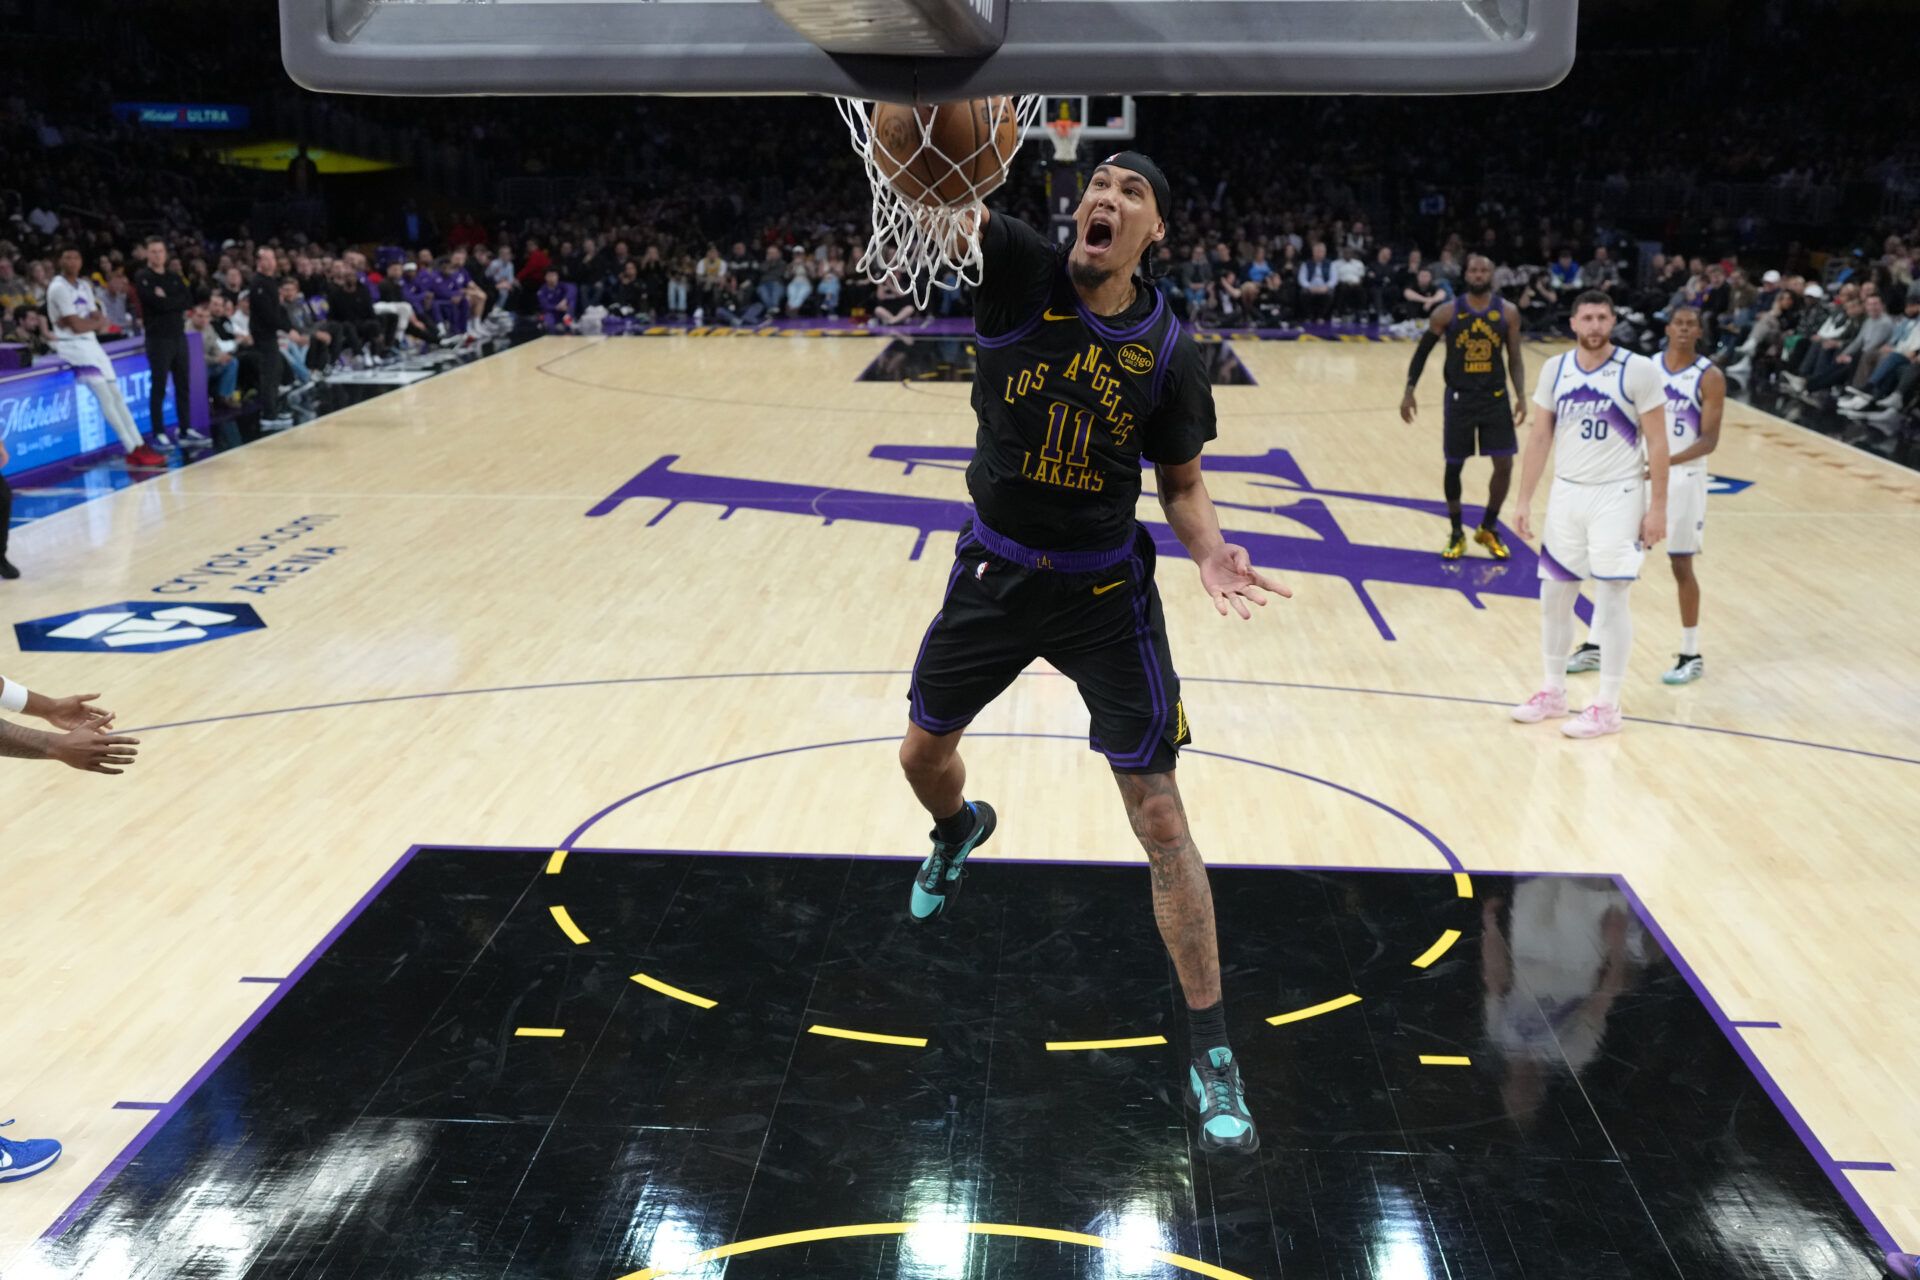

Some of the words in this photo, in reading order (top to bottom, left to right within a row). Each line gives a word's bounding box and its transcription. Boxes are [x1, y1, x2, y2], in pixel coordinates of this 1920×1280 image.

[1122, 348, 1151, 368] bibigo
[1004, 362, 1049, 404] LOS
[1063, 343, 1134, 446] ANGELES
[1040, 401, 1095, 468] 11
[1581, 418, 1608, 441] 30
[1673, 417, 1685, 437] 5
[1022, 451, 1106, 492] LAKERS
[151, 514, 341, 594] crypto.com
[229, 546, 348, 594] ARENA
[1036, 554, 1054, 570] LAL
